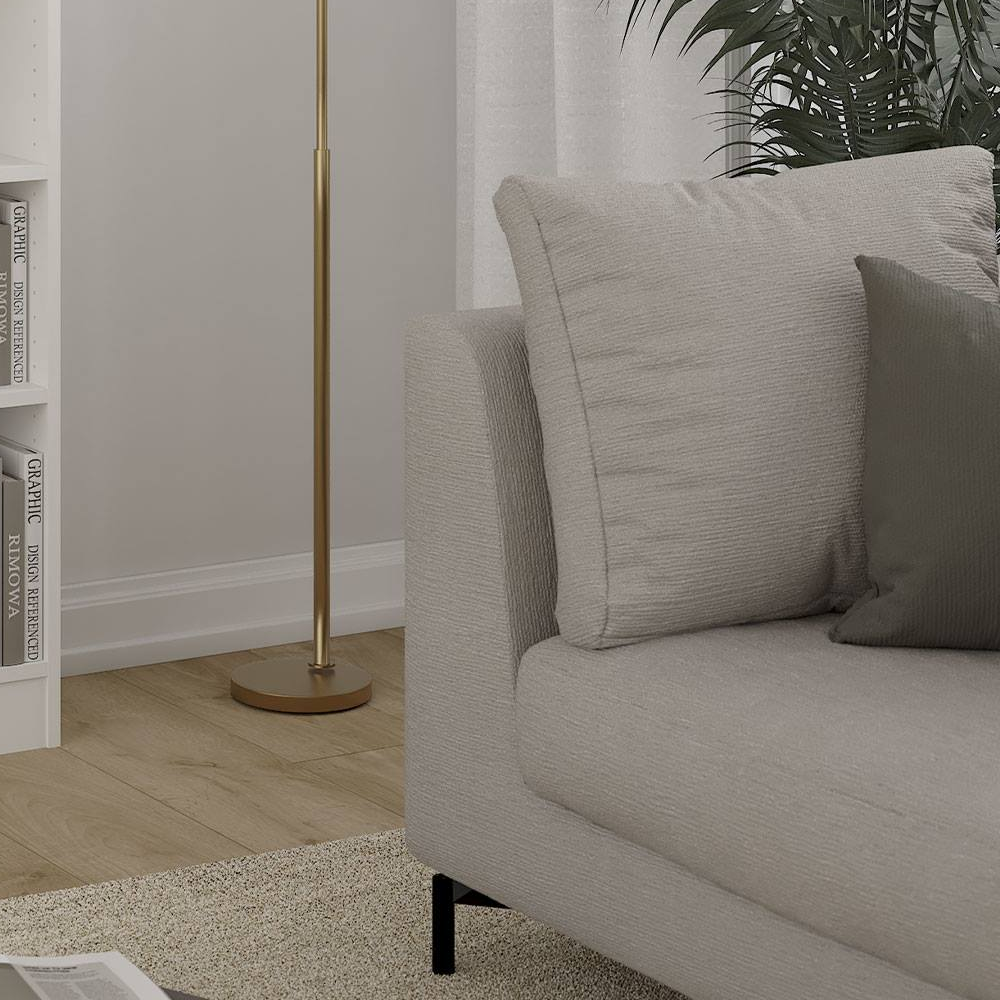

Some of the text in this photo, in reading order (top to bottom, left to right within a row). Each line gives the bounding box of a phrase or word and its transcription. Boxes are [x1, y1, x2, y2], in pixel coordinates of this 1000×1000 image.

[13, 205, 26, 263] GRAPHIC
[13, 320, 24, 383] REFERENCED
[9, 533, 21, 619] RIMOWA
[28, 458, 41, 661] GRAPHIC DISIGN REFERENCED
